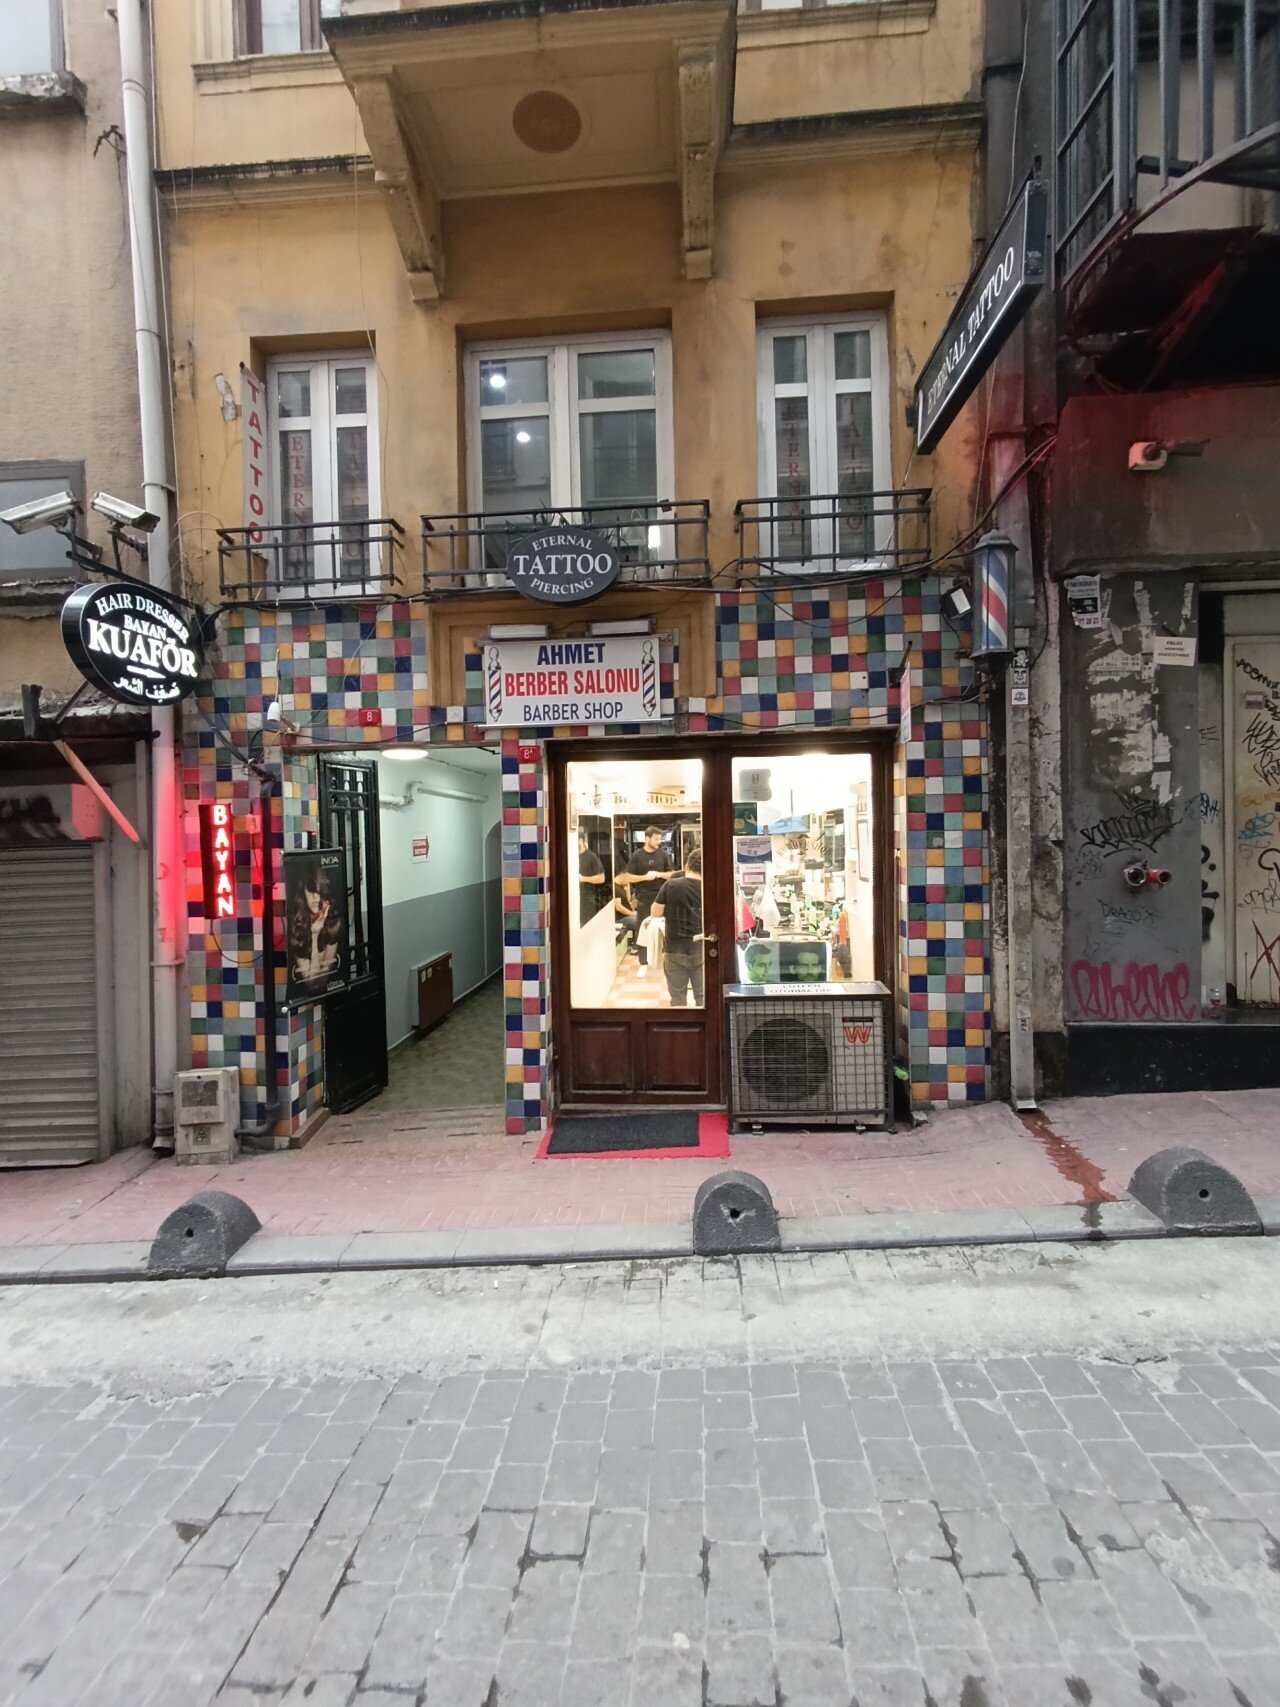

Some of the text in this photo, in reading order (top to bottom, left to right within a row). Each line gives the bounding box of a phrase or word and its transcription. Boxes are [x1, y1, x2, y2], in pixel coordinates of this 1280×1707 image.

[927, 246, 1014, 415] ETERNAL TATTOO
[247, 380, 264, 543] TATTOO
[532, 534, 593, 552] ETERNAL
[514, 553, 612, 576] TATTOO
[530, 577, 594, 595] PIERCING
[95, 593, 190, 644] HAIR DRESSER
[123, 614, 167, 641] BAYAN
[86, 618, 198, 678] KUAFÖR
[537, 642, 606, 666] AHMET
[504, 668, 640, 697] BERBER SALONU
[366, 711, 373, 722] 8
[523, 701, 623, 722] BARBER SHOP
[213, 805, 234, 917] BAYAN
